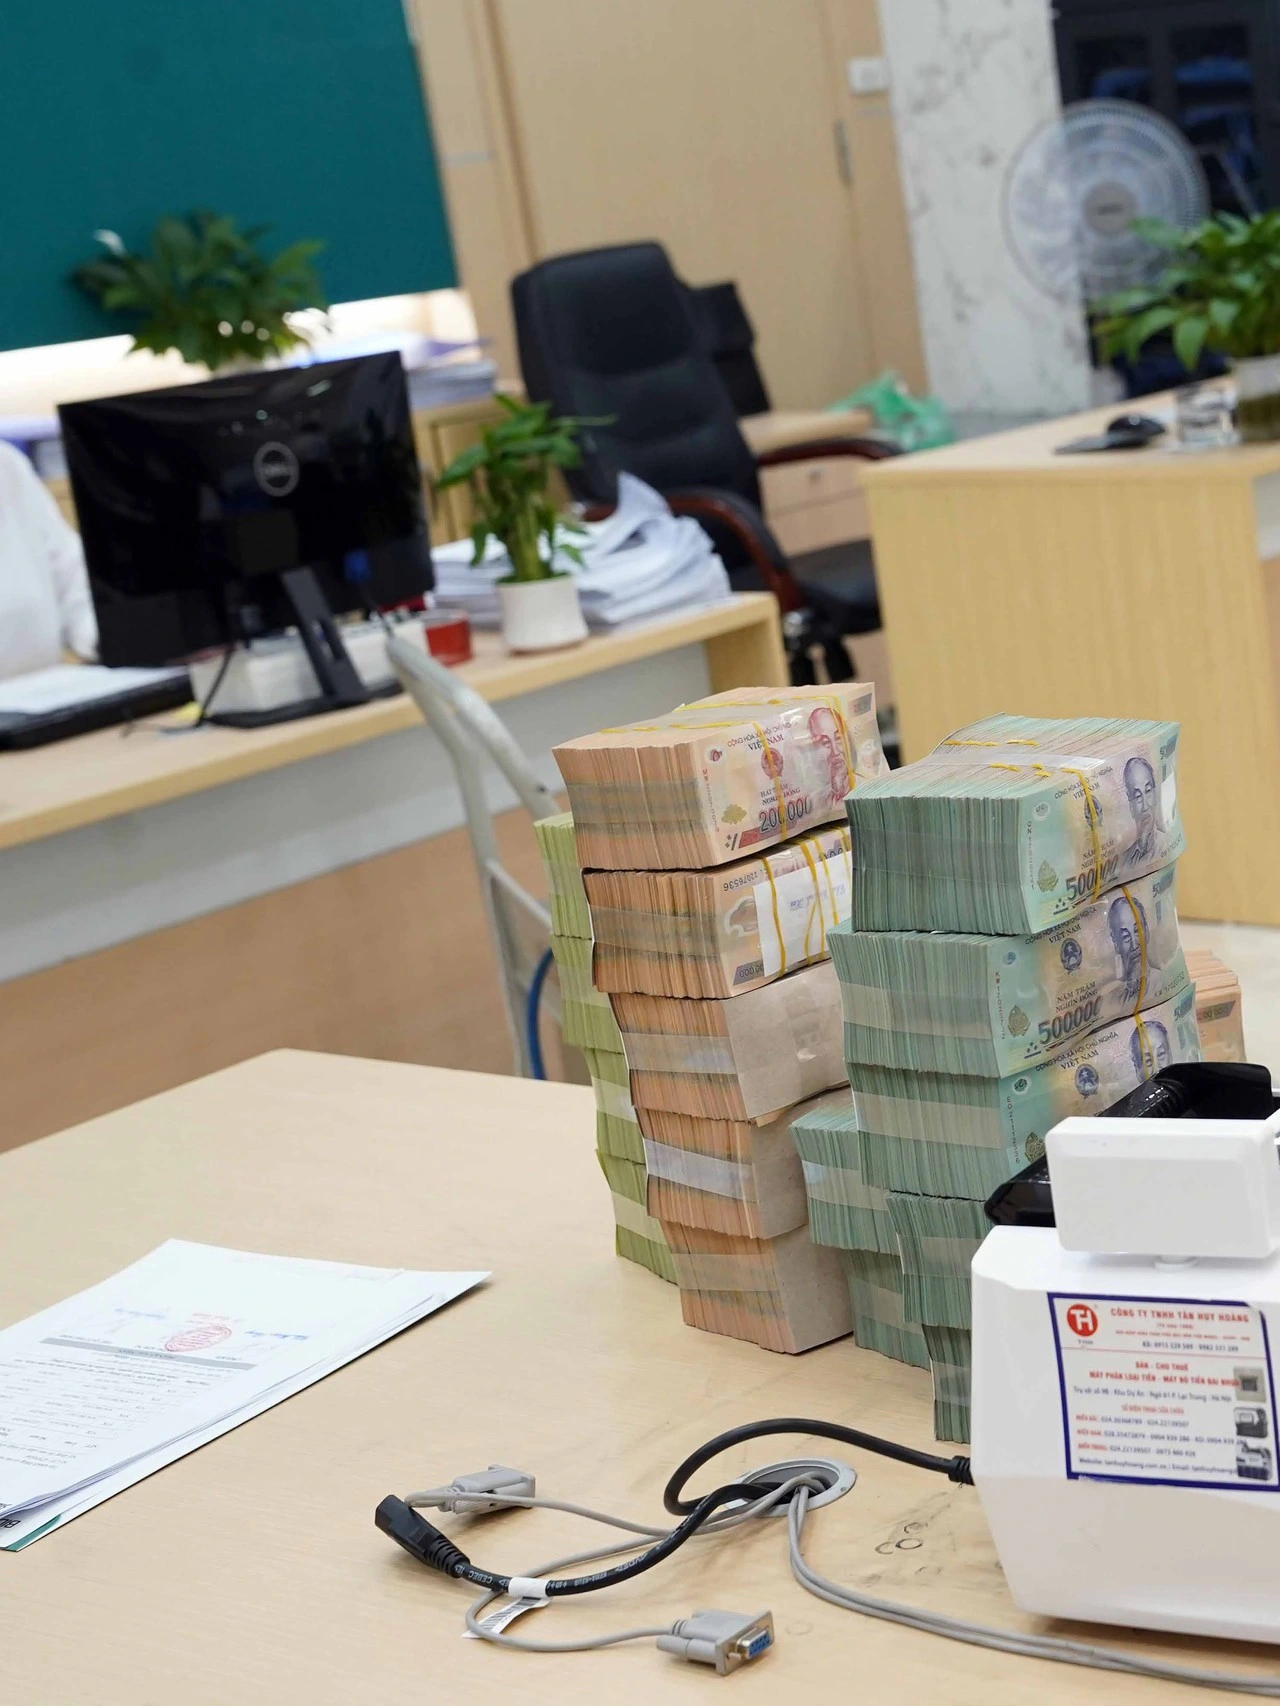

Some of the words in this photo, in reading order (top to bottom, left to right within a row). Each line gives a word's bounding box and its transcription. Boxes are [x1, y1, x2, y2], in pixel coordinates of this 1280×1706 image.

[1048, 931, 1065, 944] VIỆT
[1065, 923, 1082, 937] NAM
[1035, 1058, 1053, 1072] CỘNG
[1085, 1039, 1098, 1052] CHỦ
[1097, 1030, 1119, 1046] NGHĨA
[1060, 1057, 1080, 1071] VIỆT
[1079, 1049, 1099, 1063] NAM
[1110, 1307, 1135, 1318] CÔNG
[1137, 1309, 1148, 1318] TY
[1151, 1310, 1175, 1319] TNHH
[1178, 1309, 1195, 1320] TÂN
[1198, 1312, 1215, 1321] HUY
[1218, 1312, 1249, 1323] HOÀNG
[468, 1569, 494, 1585] CEBEC
